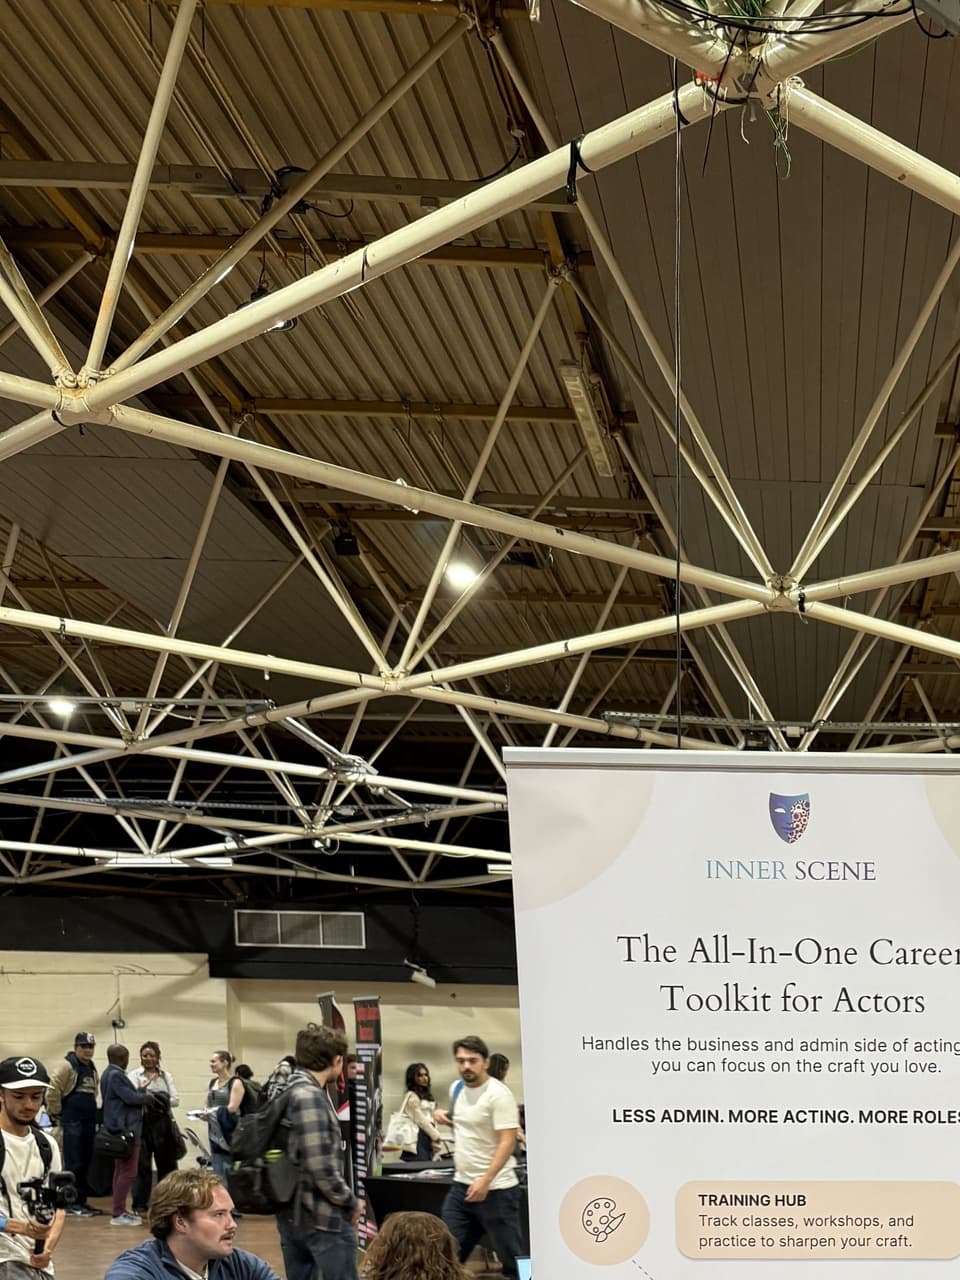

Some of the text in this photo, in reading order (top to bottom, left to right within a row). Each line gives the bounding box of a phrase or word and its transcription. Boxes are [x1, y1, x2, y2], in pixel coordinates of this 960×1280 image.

[707, 860, 876, 881] INNER SCENE
[617, 933, 677, 963] The
[688, 934, 858, 965] All-In-One
[660, 982, 925, 1013] Toolkit for Actors
[582, 1036, 649, 1051] Handles
[654, 1037, 681, 1051] the
[687, 1037, 759, 1052] business
[764, 1038, 794, 1052] and
[800, 1038, 848, 1052] admin
[854, 1038, 887, 1052] side
[892, 1038, 909, 1052] of
[651, 1057, 941, 1076] you can focus on the craft you love.
[613, 1109, 656, 1123] LESS
[660, 1109, 724, 1123] ADMIN.
[728, 1109, 778, 1123] MORE
[783, 1110, 854, 1124] ACTING.
[859, 1110, 908, 1124] MORE
[698, 1194, 806, 1207] TRAINING HUB
[698, 1214, 914, 1230] Track classes, workshops, and
[699, 1234, 912, 1250] practice to sharpen your craft.
